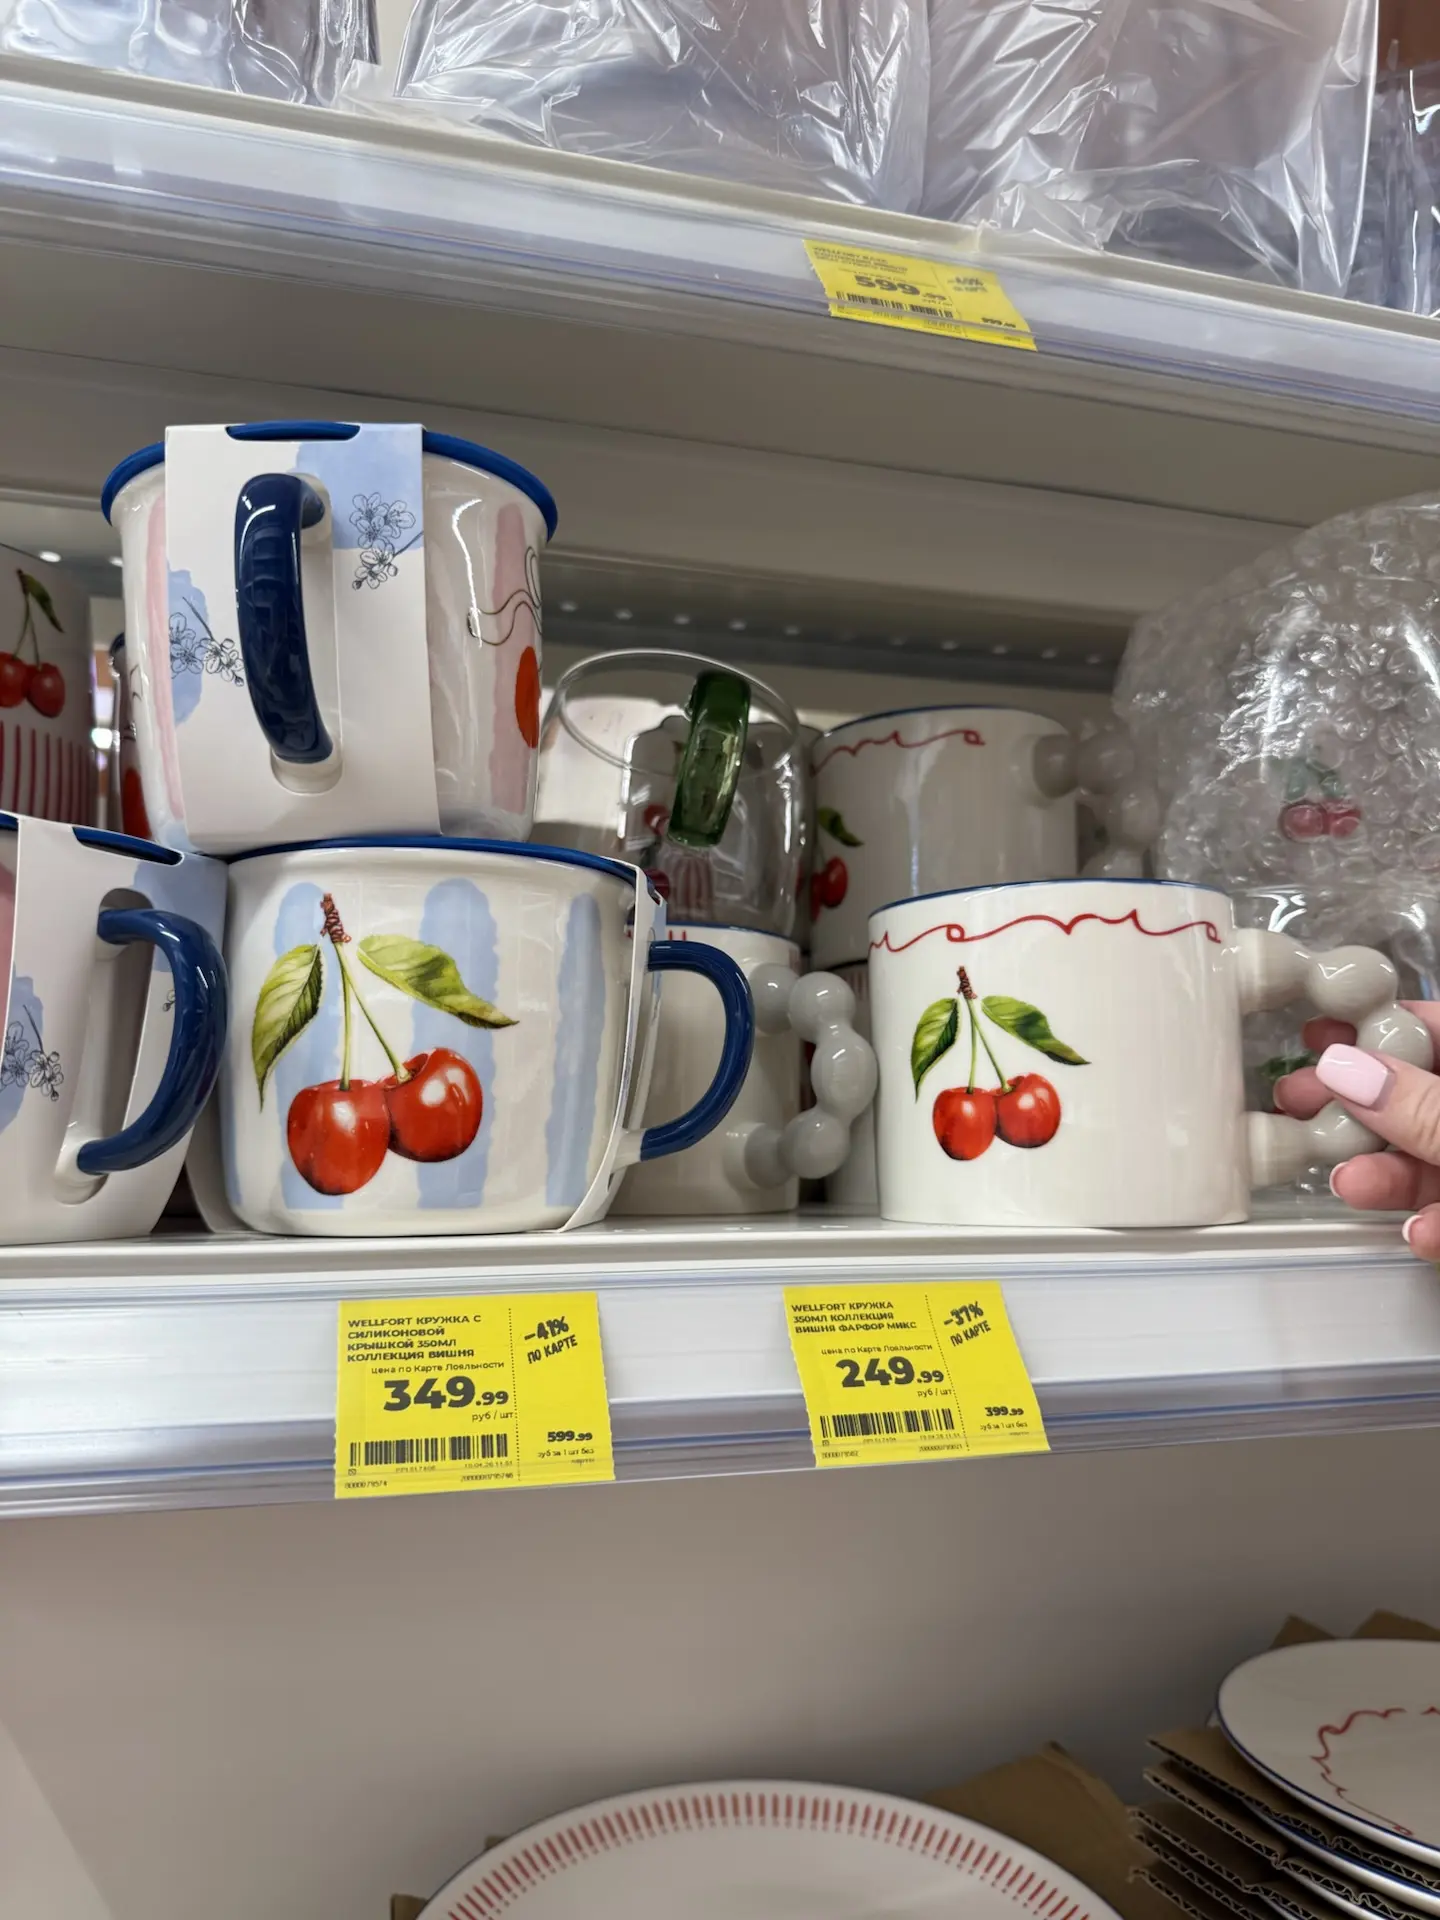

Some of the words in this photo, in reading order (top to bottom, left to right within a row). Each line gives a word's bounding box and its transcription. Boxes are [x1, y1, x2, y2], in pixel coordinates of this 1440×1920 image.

[791, 1302, 846, 1313] WELLFORT
[849, 1301, 894, 1311] КРУЖКА
[943, 1301, 984, 1326] -37%
[348, 1317, 413, 1328] WELLFORT
[416, 1315, 470, 1326] КРУЖКА
[473, 1315, 482, 1323] С
[793, 1315, 827, 1324] 350МЛ
[830, 1312, 894, 1322] КОЛЛЕКЦИЯ
[348, 1326, 445, 1340] СИЛИКОНОВОЙ
[524, 1316, 569, 1341] -41%
[795, 1324, 836, 1334] ВИШНЯ
[838, 1322, 885, 1332] ФАРФОР
[887, 1321, 917, 1330] МИКС
[950, 1334, 964, 1347] ПО
[965, 1320, 991, 1341] КАРТЕ
[347, 1339, 413, 1351] КРЫШКОЙ
[417, 1339, 457, 1348] 350МЛ
[527, 1349, 542, 1364] ПО
[544, 1335, 578, 1358] КАРТЕ
[821, 1347, 843, 1355] цена
[844, 1346, 856, 1354] по
[857, 1345, 882, 1355] Карте
[883, 1343, 933, 1352] Лояльности
[347, 1351, 424, 1363] КОЛЛЕКЦИЯ
[428, 1349, 475, 1359] ВИШНЯ
[371, 1365, 396, 1375] цена
[398, 1365, 411, 1373] по
[414, 1364, 443, 1374] Карте
[445, 1361, 505, 1372] Лояльности
[917, 1389, 933, 1398] руб
[471, 1411, 492, 1423] руб
[500, 1411, 514, 1420] шт
